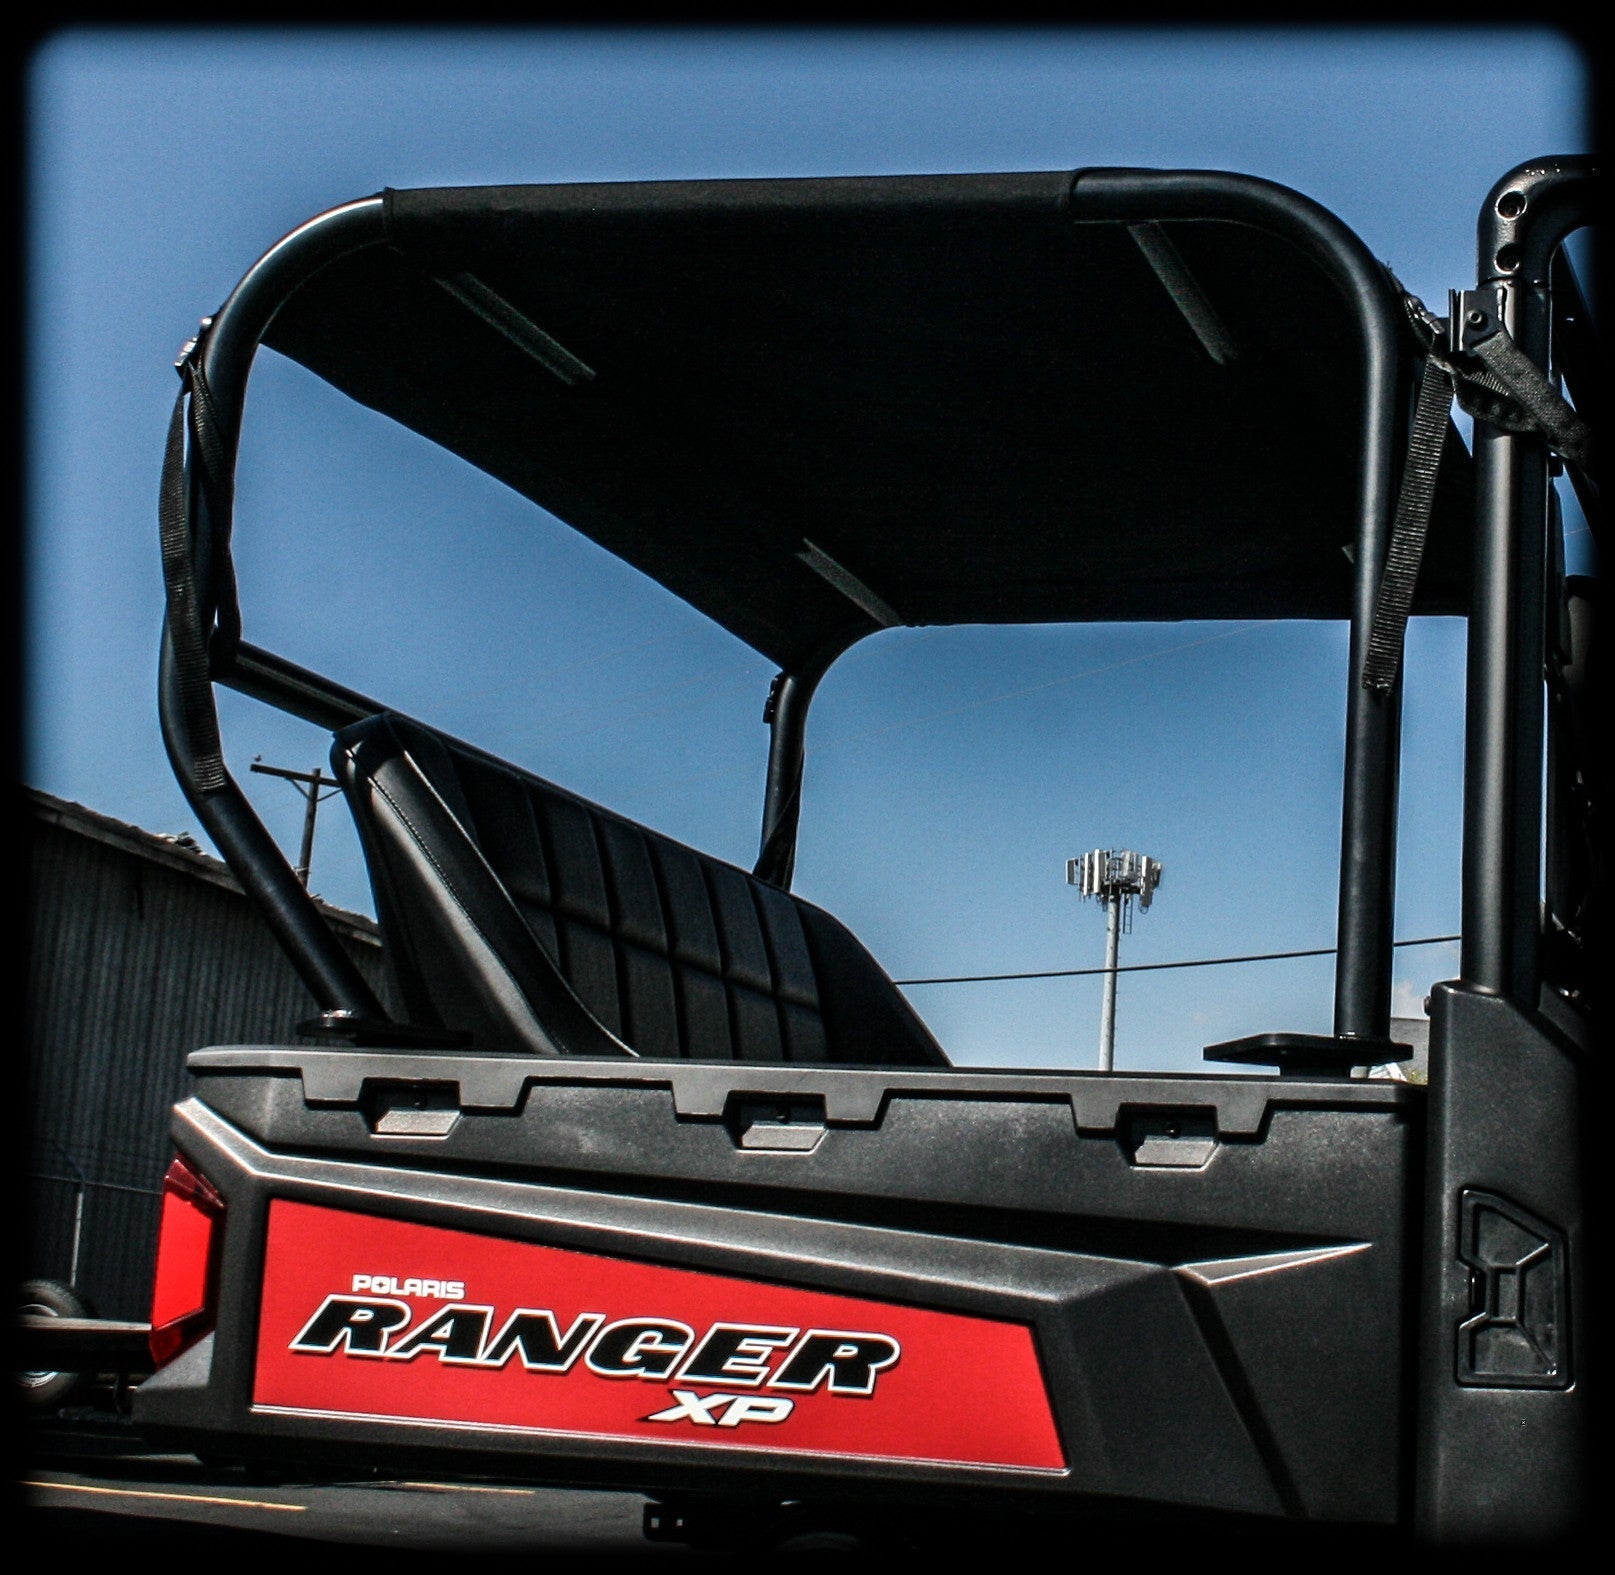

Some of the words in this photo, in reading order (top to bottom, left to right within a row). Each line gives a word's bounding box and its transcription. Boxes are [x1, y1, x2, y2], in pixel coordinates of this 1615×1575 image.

[352, 1274, 465, 1300] POLARIS
[289, 1295, 900, 1395] RANGER
[648, 1390, 795, 1427] XP
